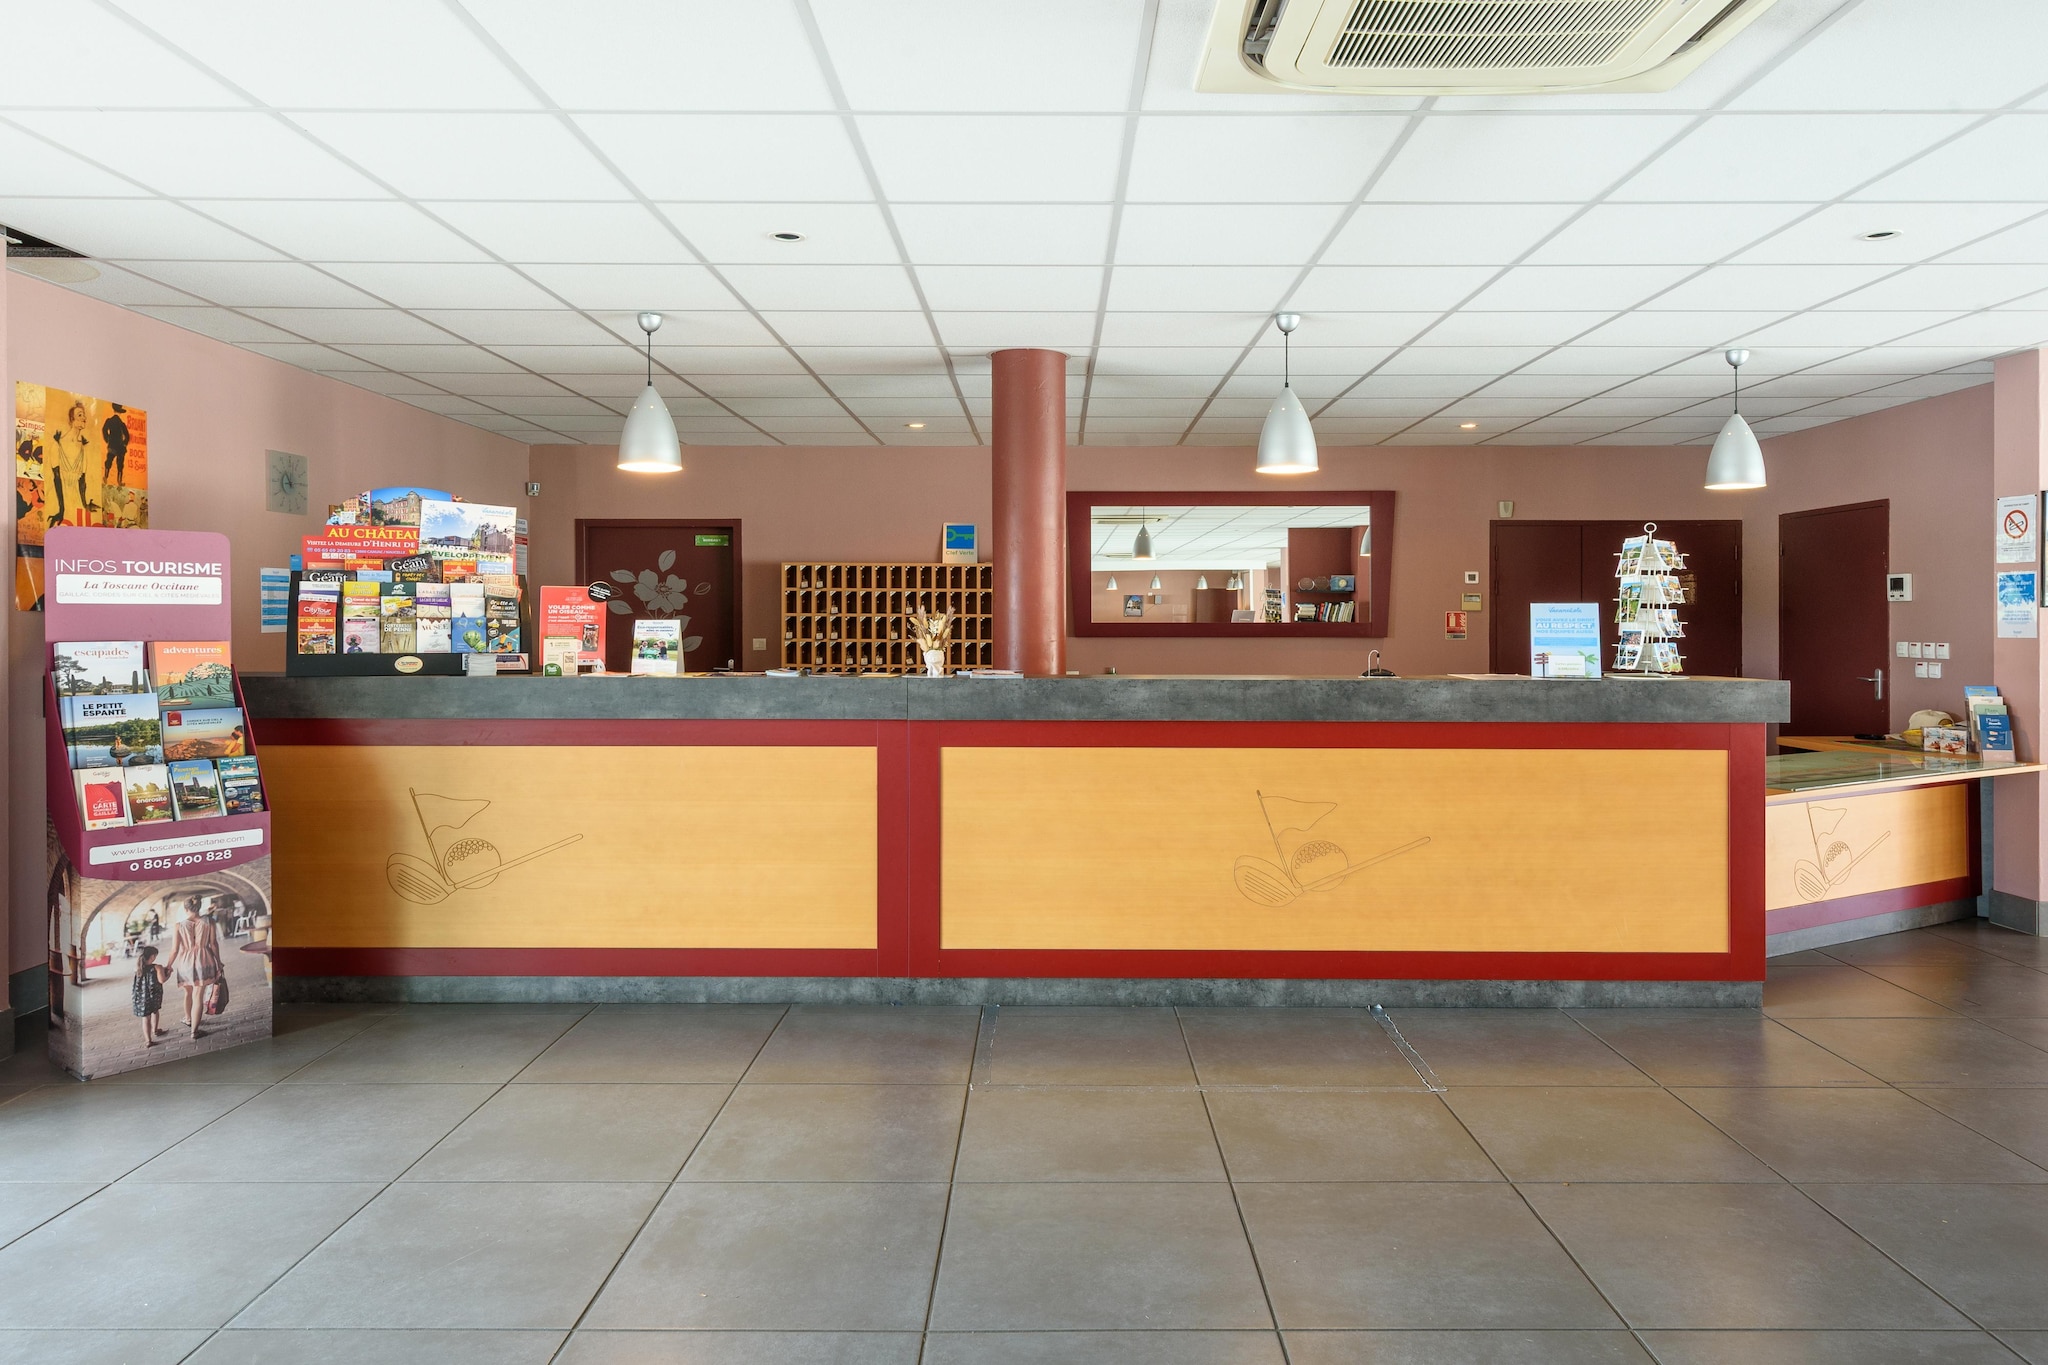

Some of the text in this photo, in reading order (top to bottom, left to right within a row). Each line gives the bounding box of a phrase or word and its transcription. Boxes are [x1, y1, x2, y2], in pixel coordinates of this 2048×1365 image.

[130, 449, 144, 459] BOCK
[128, 460, 134, 468] 13
[328, 528, 350, 538] AU
[55, 559, 222, 575] INFOS TOURISME
[391, 557, 428, 572] Géant
[309, 572, 349, 582] Géant
[83, 581, 199, 591] La Toscane Occitane
[74, 648, 129, 658] escapades
[111, 835, 245, 857] www.la-toscane-occitane.com
[129, 849, 232, 872] 0 805 400 828
